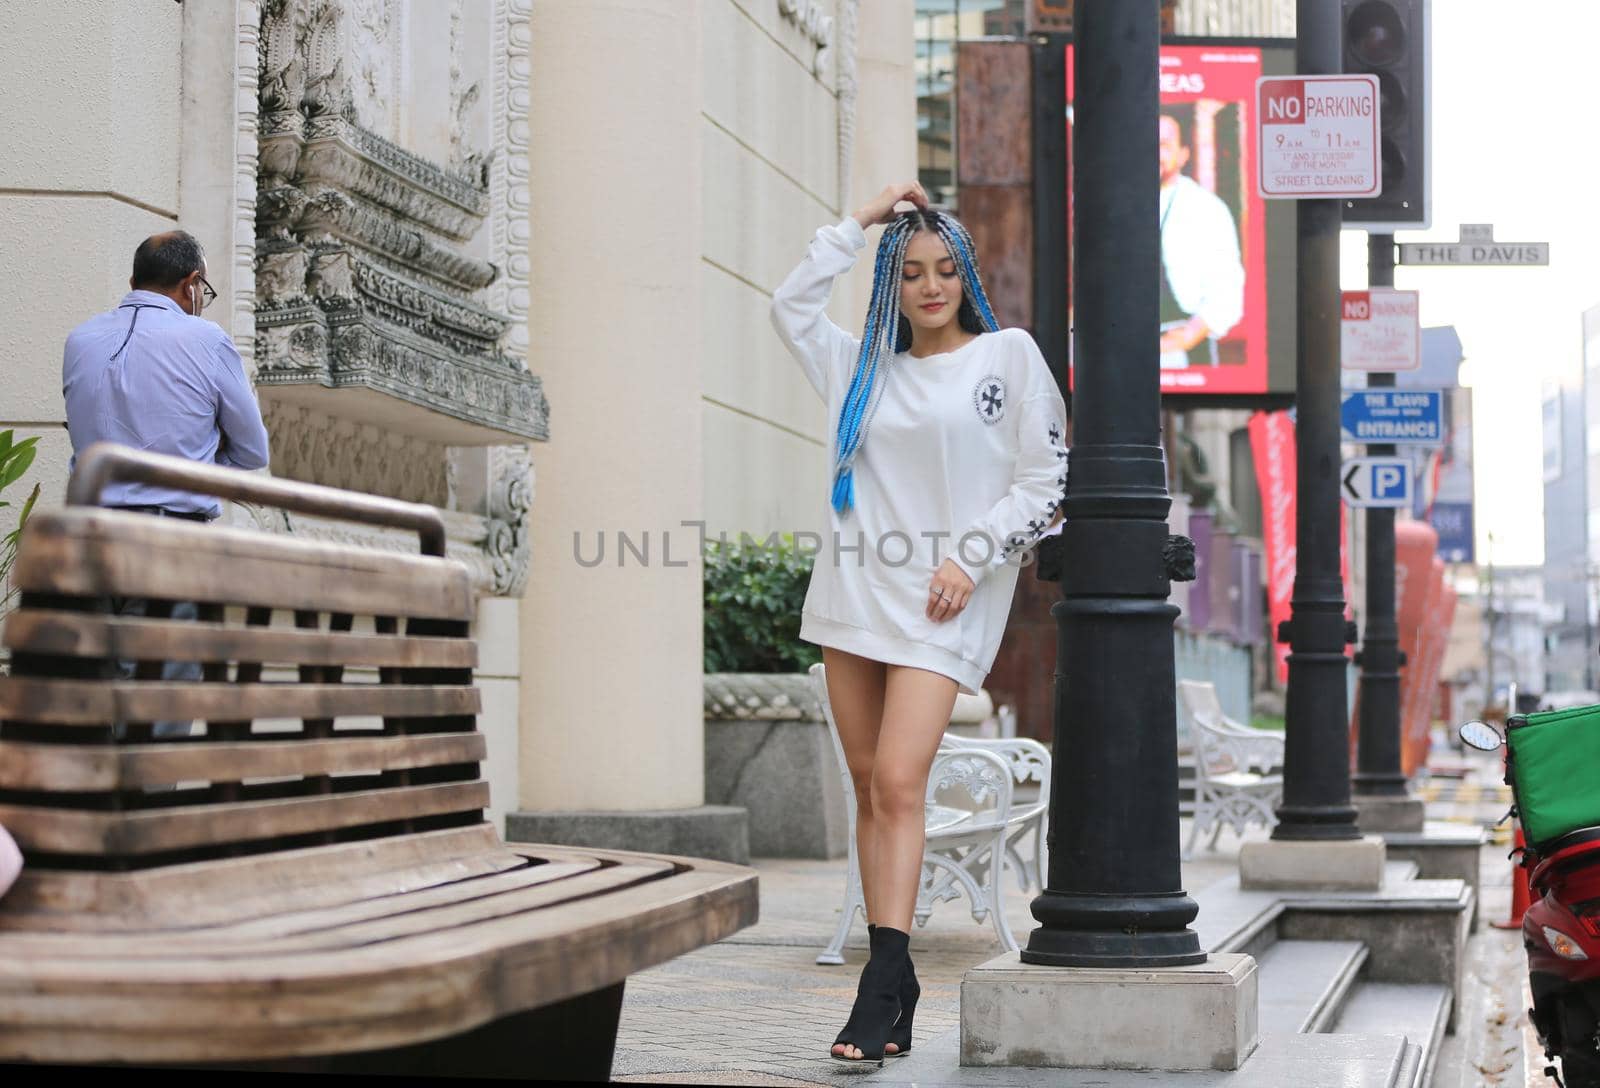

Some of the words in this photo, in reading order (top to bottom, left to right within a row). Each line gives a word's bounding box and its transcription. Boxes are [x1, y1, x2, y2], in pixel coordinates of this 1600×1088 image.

[1268, 96, 1301, 119] NO
[1306, 96, 1372, 118] PARKING
[1275, 133, 1286, 148] 9
[1326, 132, 1342, 148] 11
[1275, 175, 1311, 186] STREET
[1314, 174, 1364, 186] CLEANING
[1417, 247, 1459, 262] THE
[1471, 246, 1539, 262] DAVIS
[1344, 300, 1369, 318] NO
[1364, 393, 1387, 408] THE
[1392, 393, 1430, 408] DAVIS
[1357, 421, 1437, 438] ENTRANCE
[1375, 467, 1400, 497] P
